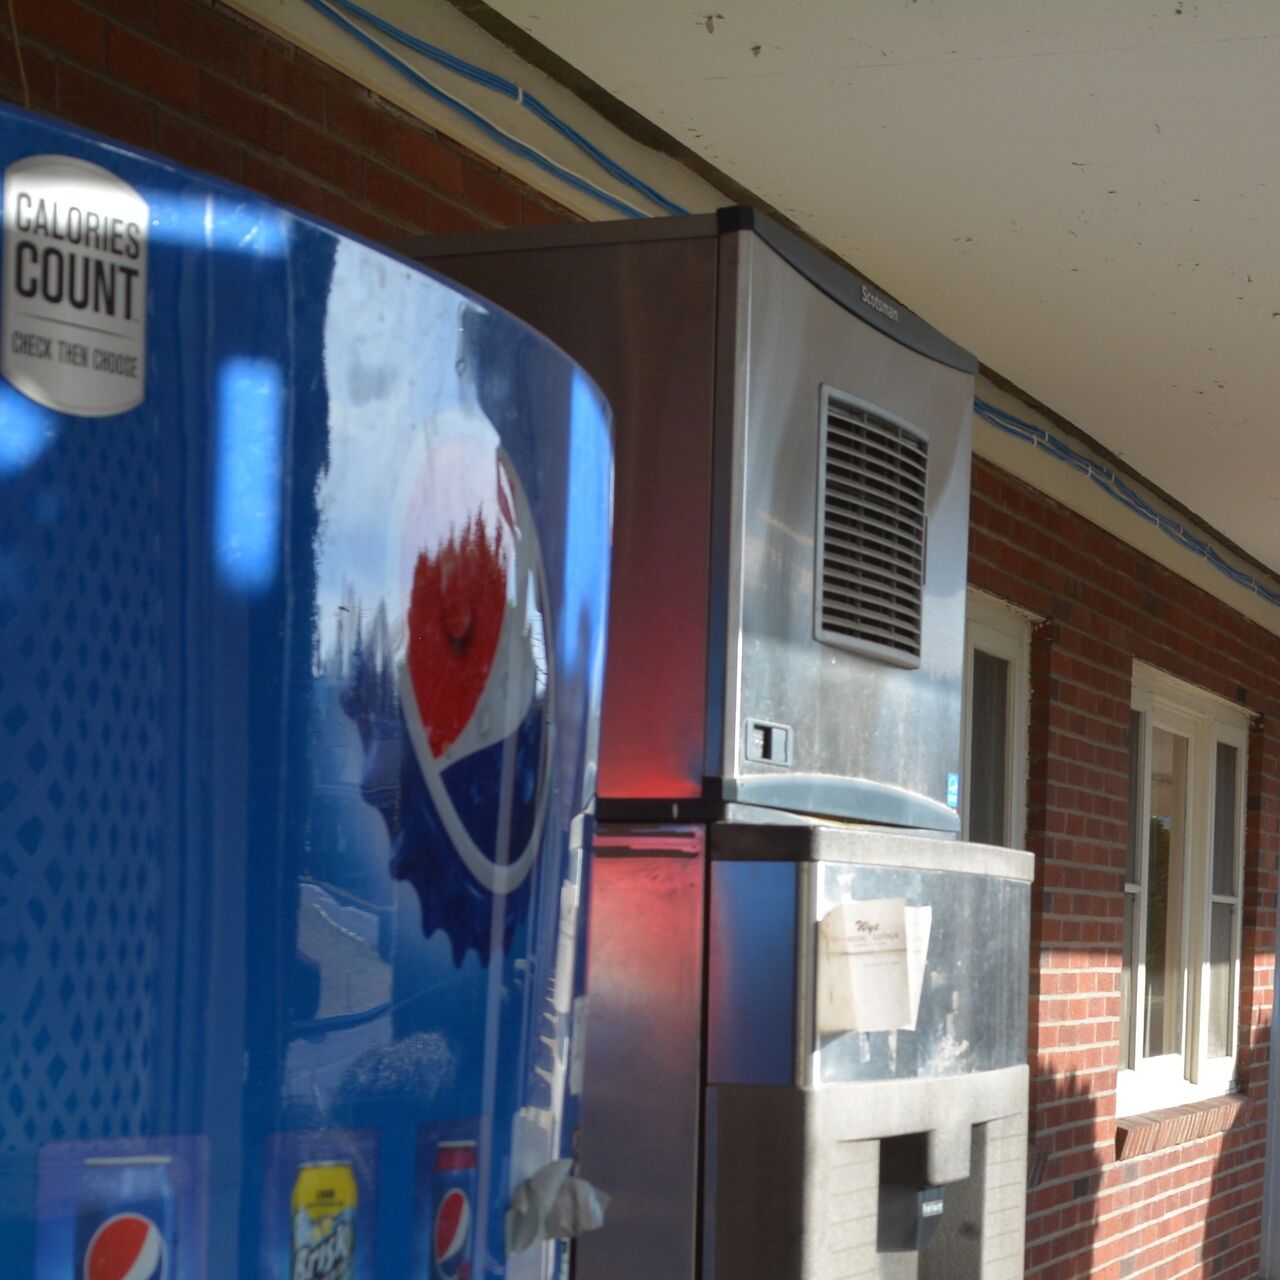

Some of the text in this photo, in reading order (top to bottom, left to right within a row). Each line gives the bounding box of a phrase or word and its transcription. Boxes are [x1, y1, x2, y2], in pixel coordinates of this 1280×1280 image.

[16, 191, 141, 261] CALORIES
[14, 238, 139, 321] COUNT
[861, 285, 898, 322] Scotsman
[11, 330, 139, 379] CHECK THEN CHOOSE
